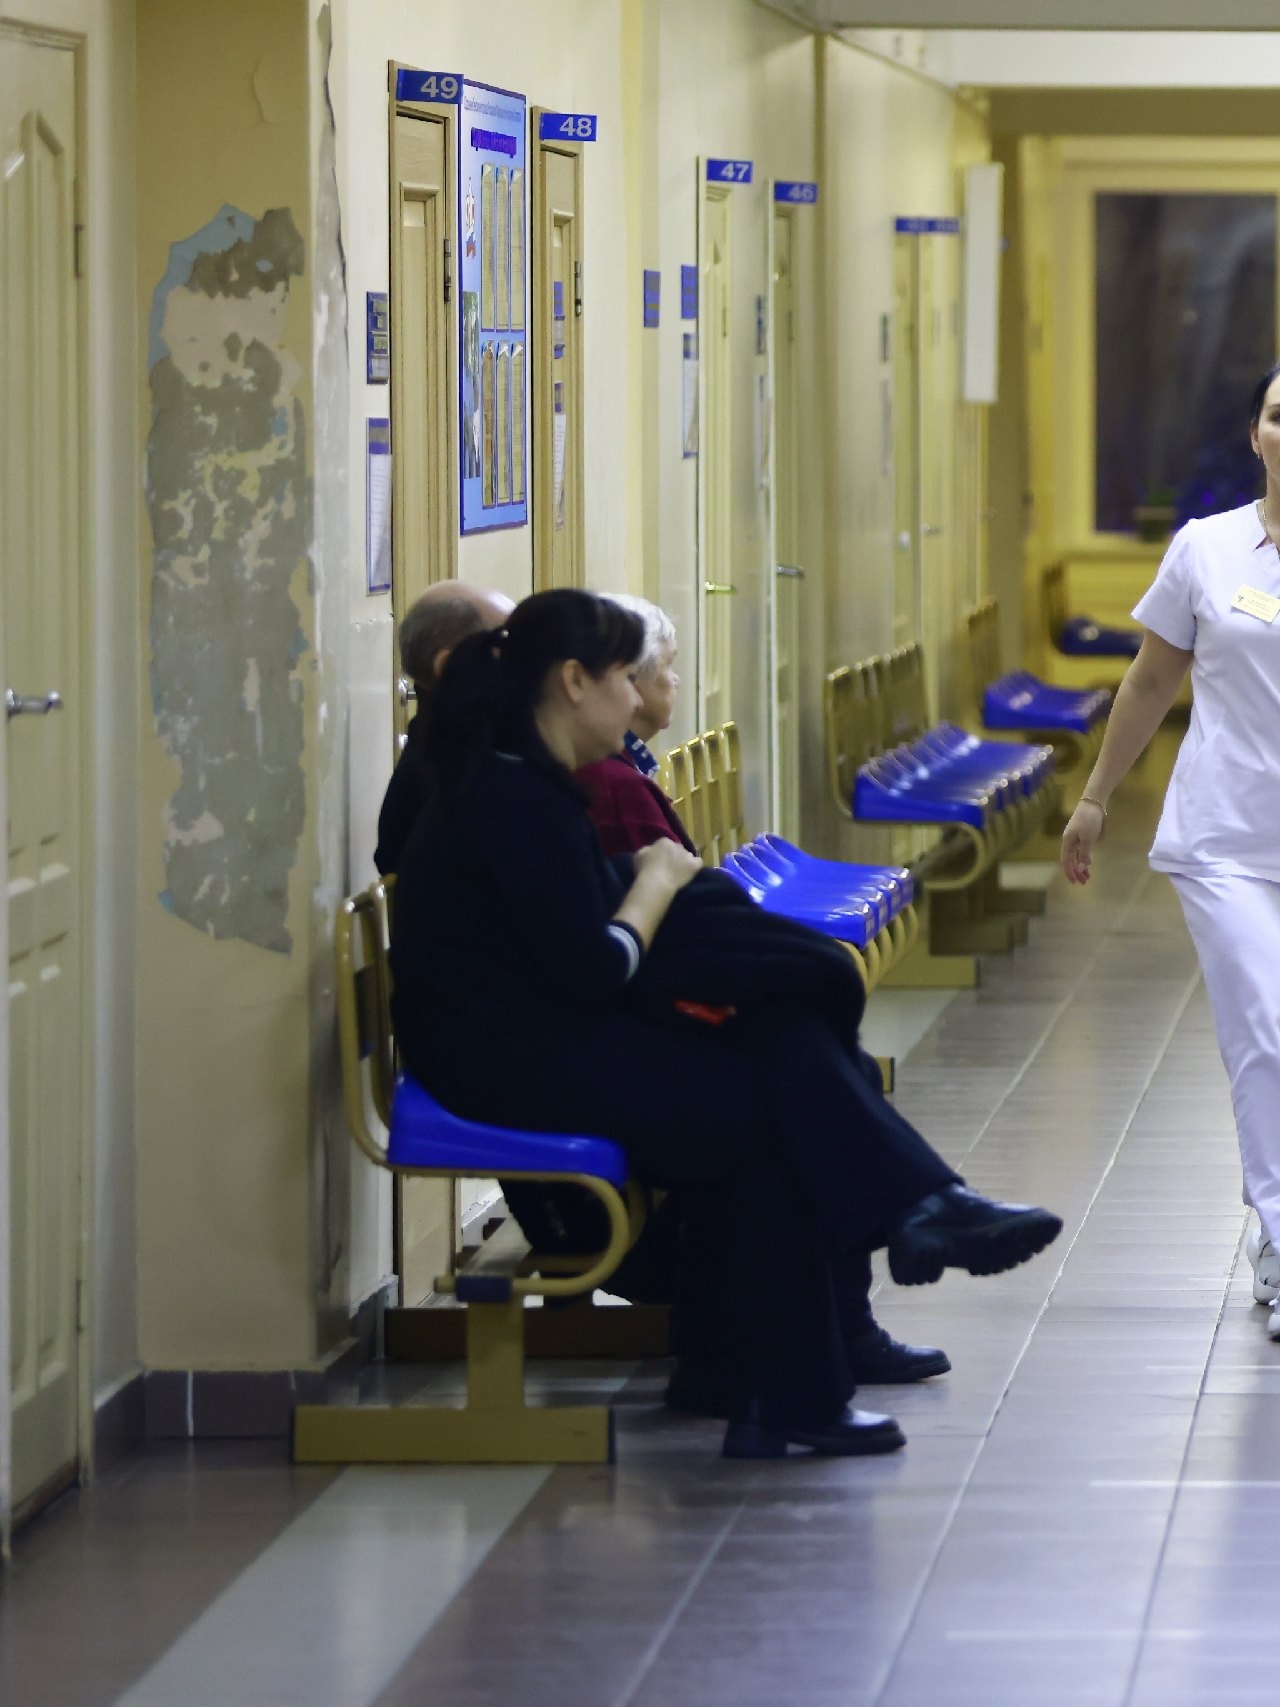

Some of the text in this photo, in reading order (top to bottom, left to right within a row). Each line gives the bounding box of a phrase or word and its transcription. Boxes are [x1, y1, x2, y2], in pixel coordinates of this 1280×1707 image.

[420, 75, 459, 99] 49
[559, 116, 593, 137] 48
[720, 162, 750, 181] 47
[788, 183, 815, 200] 46
